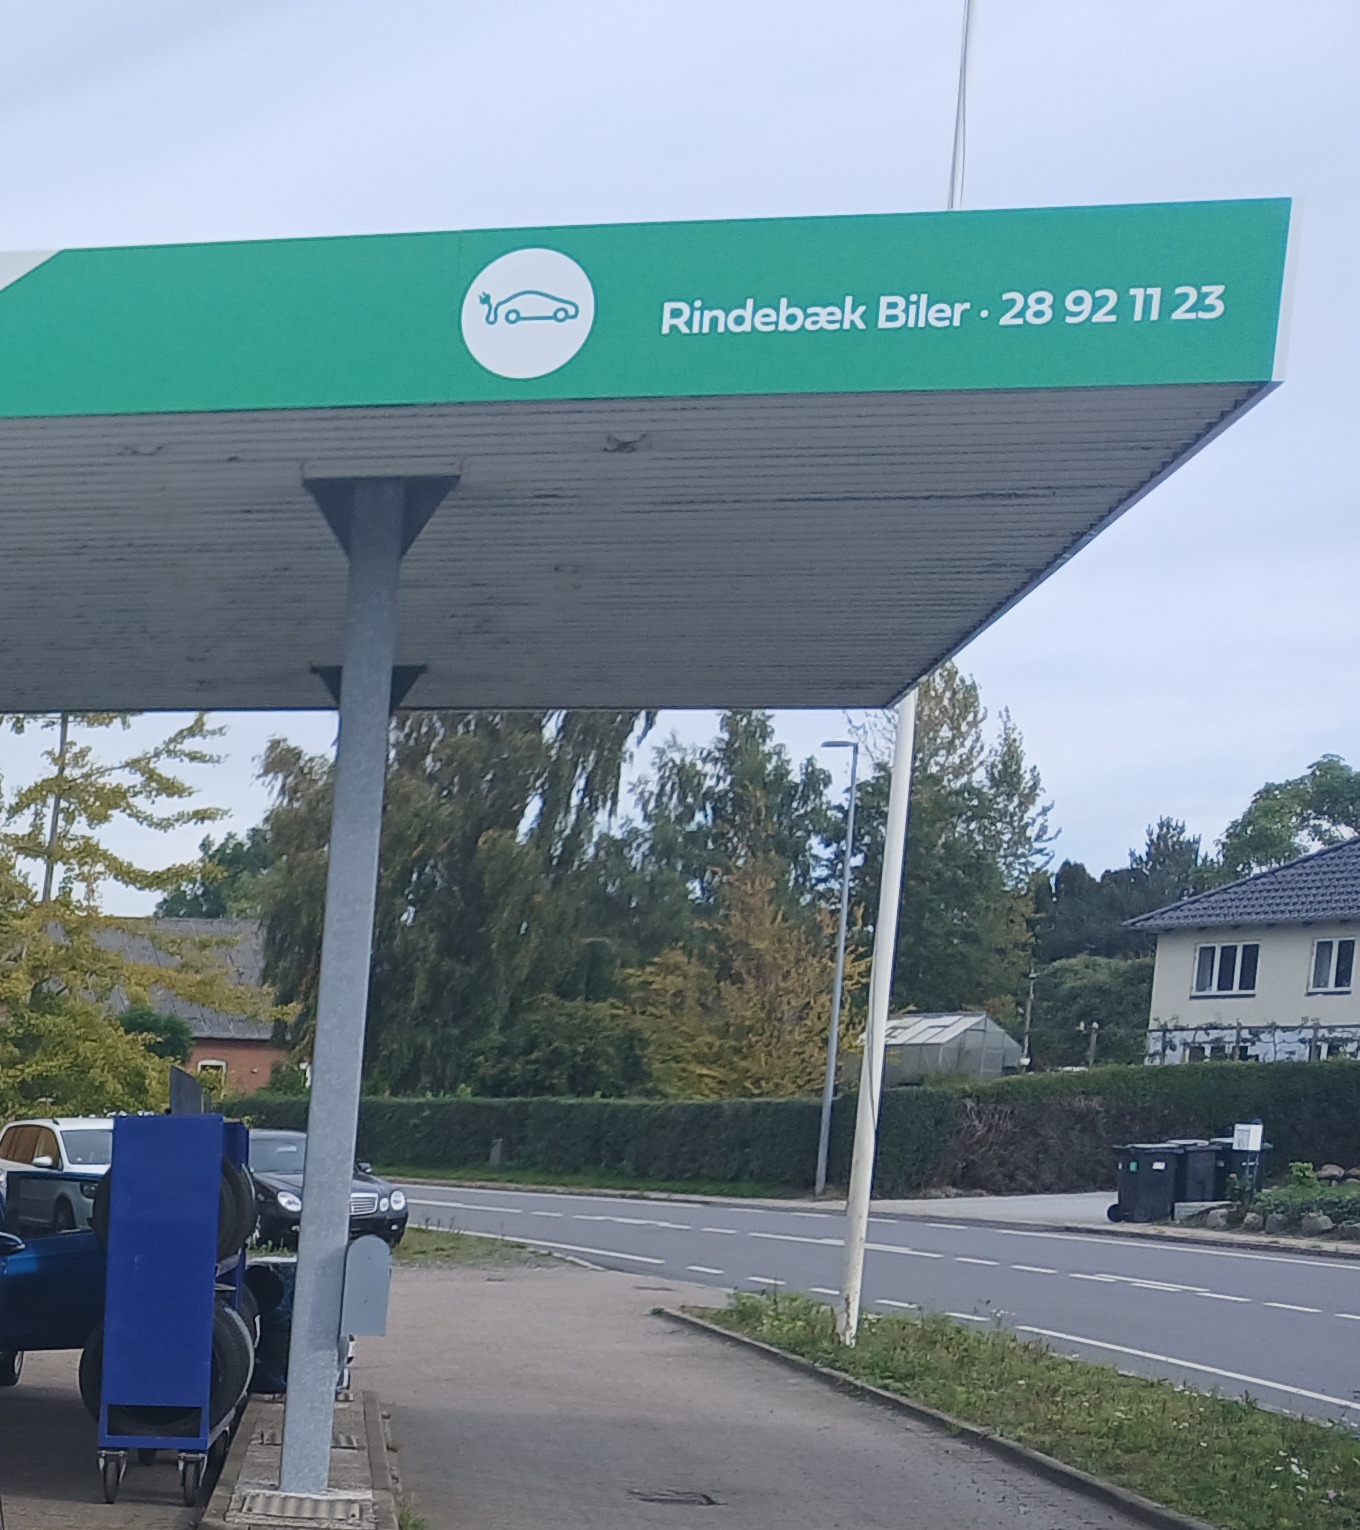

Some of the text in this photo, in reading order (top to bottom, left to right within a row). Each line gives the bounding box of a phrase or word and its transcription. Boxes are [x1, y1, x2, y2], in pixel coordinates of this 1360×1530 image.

[660, 284, 1226, 335] Rindebæk Biler 28 92 11 23
